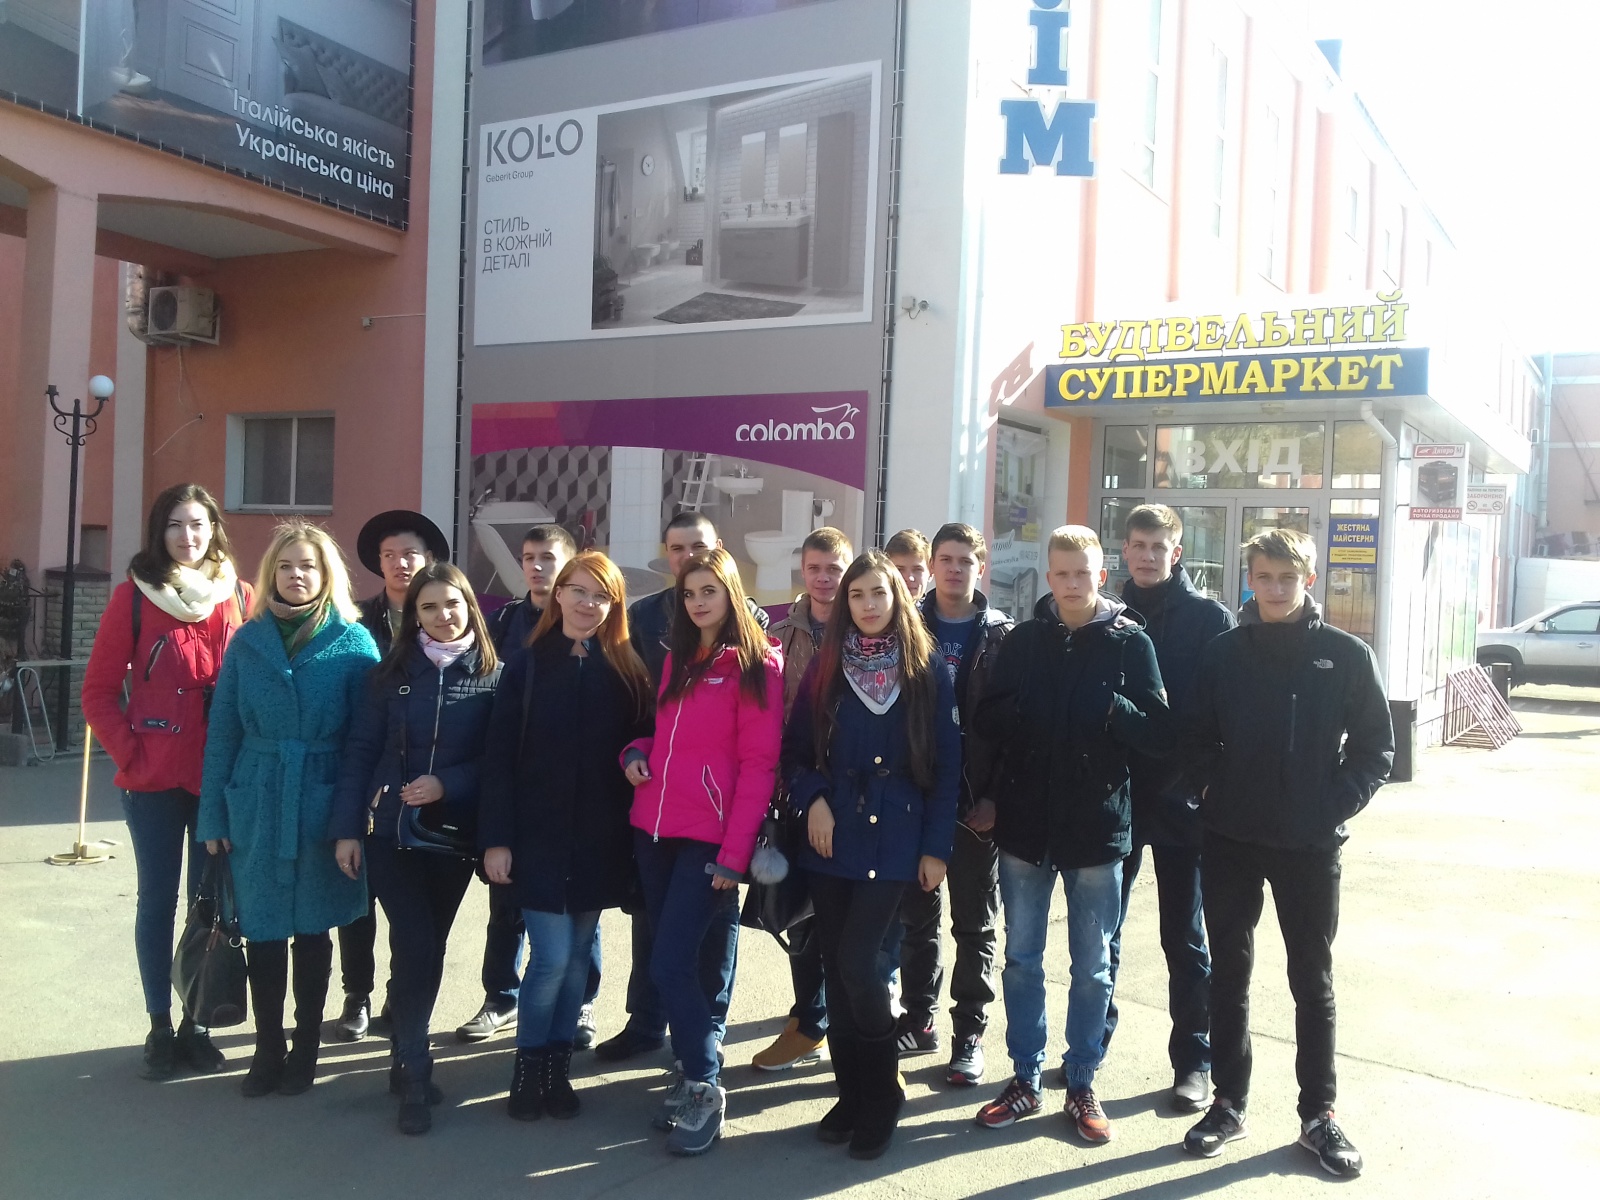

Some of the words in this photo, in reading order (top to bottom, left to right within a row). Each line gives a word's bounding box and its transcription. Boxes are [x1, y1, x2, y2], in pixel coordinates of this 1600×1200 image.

[233, 88, 338, 149] Італійська
[342, 136, 395, 169] якість
[235, 122, 353, 185] Українська
[356, 171, 394, 200] ціна
[485, 171, 512, 183] Geberit
[512, 170, 534, 180] Group
[484, 216, 530, 235] СТИЛЬ
[483, 238, 492, 253] В
[496, 228, 552, 252] КОЖНІЙ
[482, 252, 530, 274] ДЕТАЛІ
[1059, 290, 1409, 363] БУДІВЕЛЬНИЙ
[1058, 354, 1403, 401] СУПЕРМАРКЕТ
[735, 417, 855, 441] colombo
[1178, 438, 1302, 480] ВХІД
[1333, 534, 1374, 543] МАЙСТЕРНЯ
[1337, 524, 1370, 532] ЖЕСТЯНА
